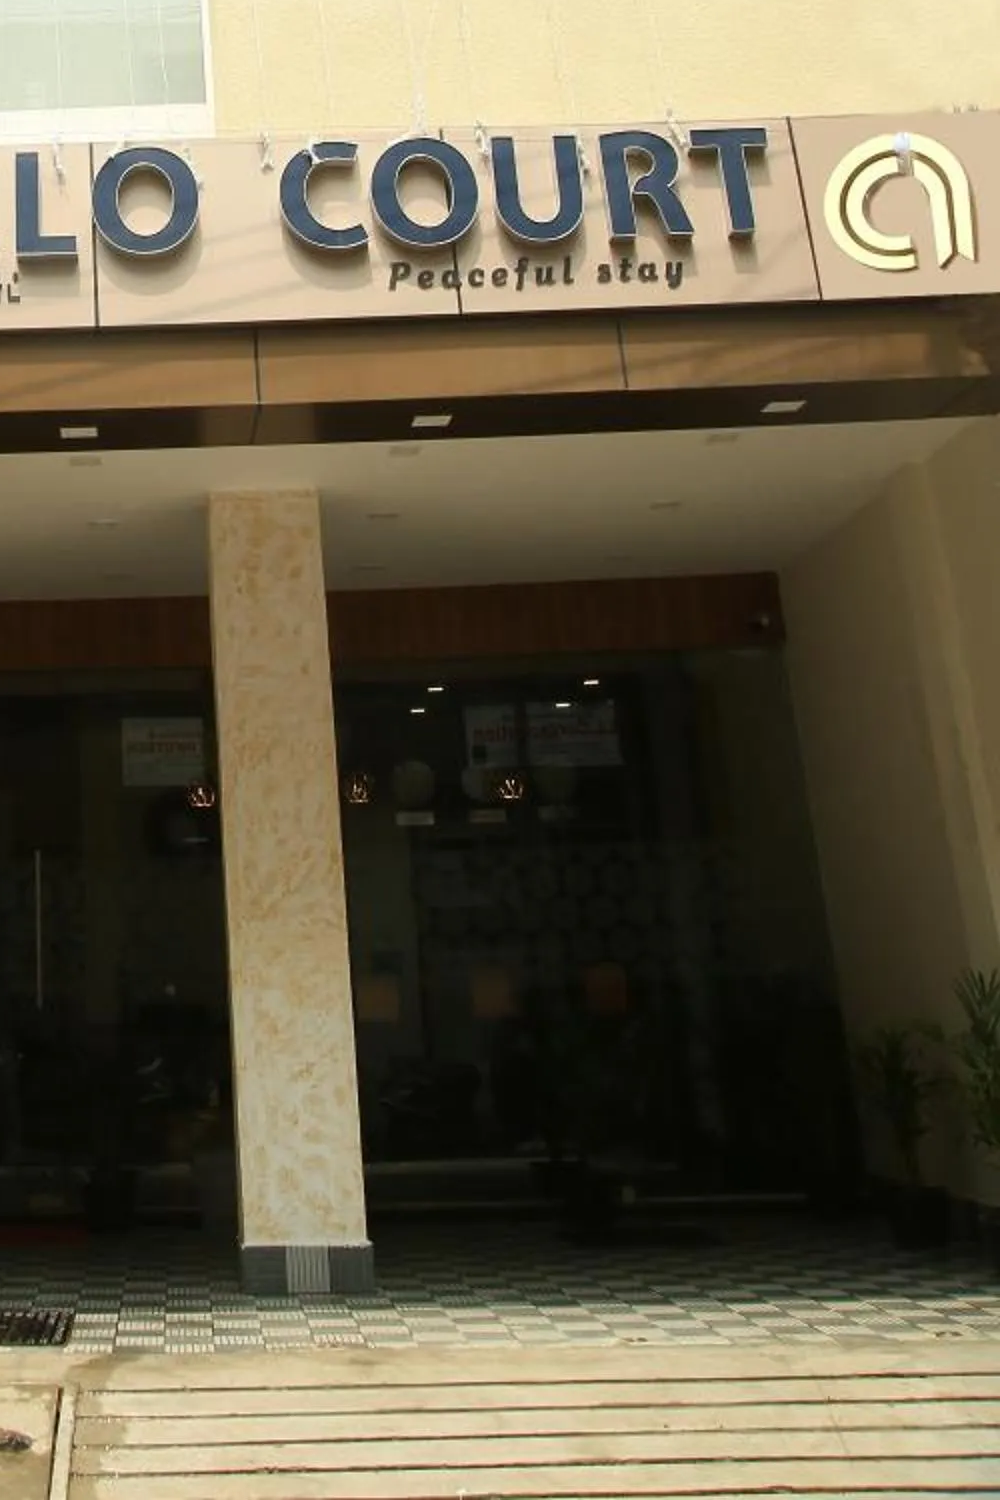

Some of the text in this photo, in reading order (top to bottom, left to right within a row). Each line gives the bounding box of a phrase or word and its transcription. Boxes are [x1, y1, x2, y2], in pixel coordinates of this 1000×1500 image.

[279, 127, 768, 249] COURT
[388, 255, 684, 292] Peaceful stay
